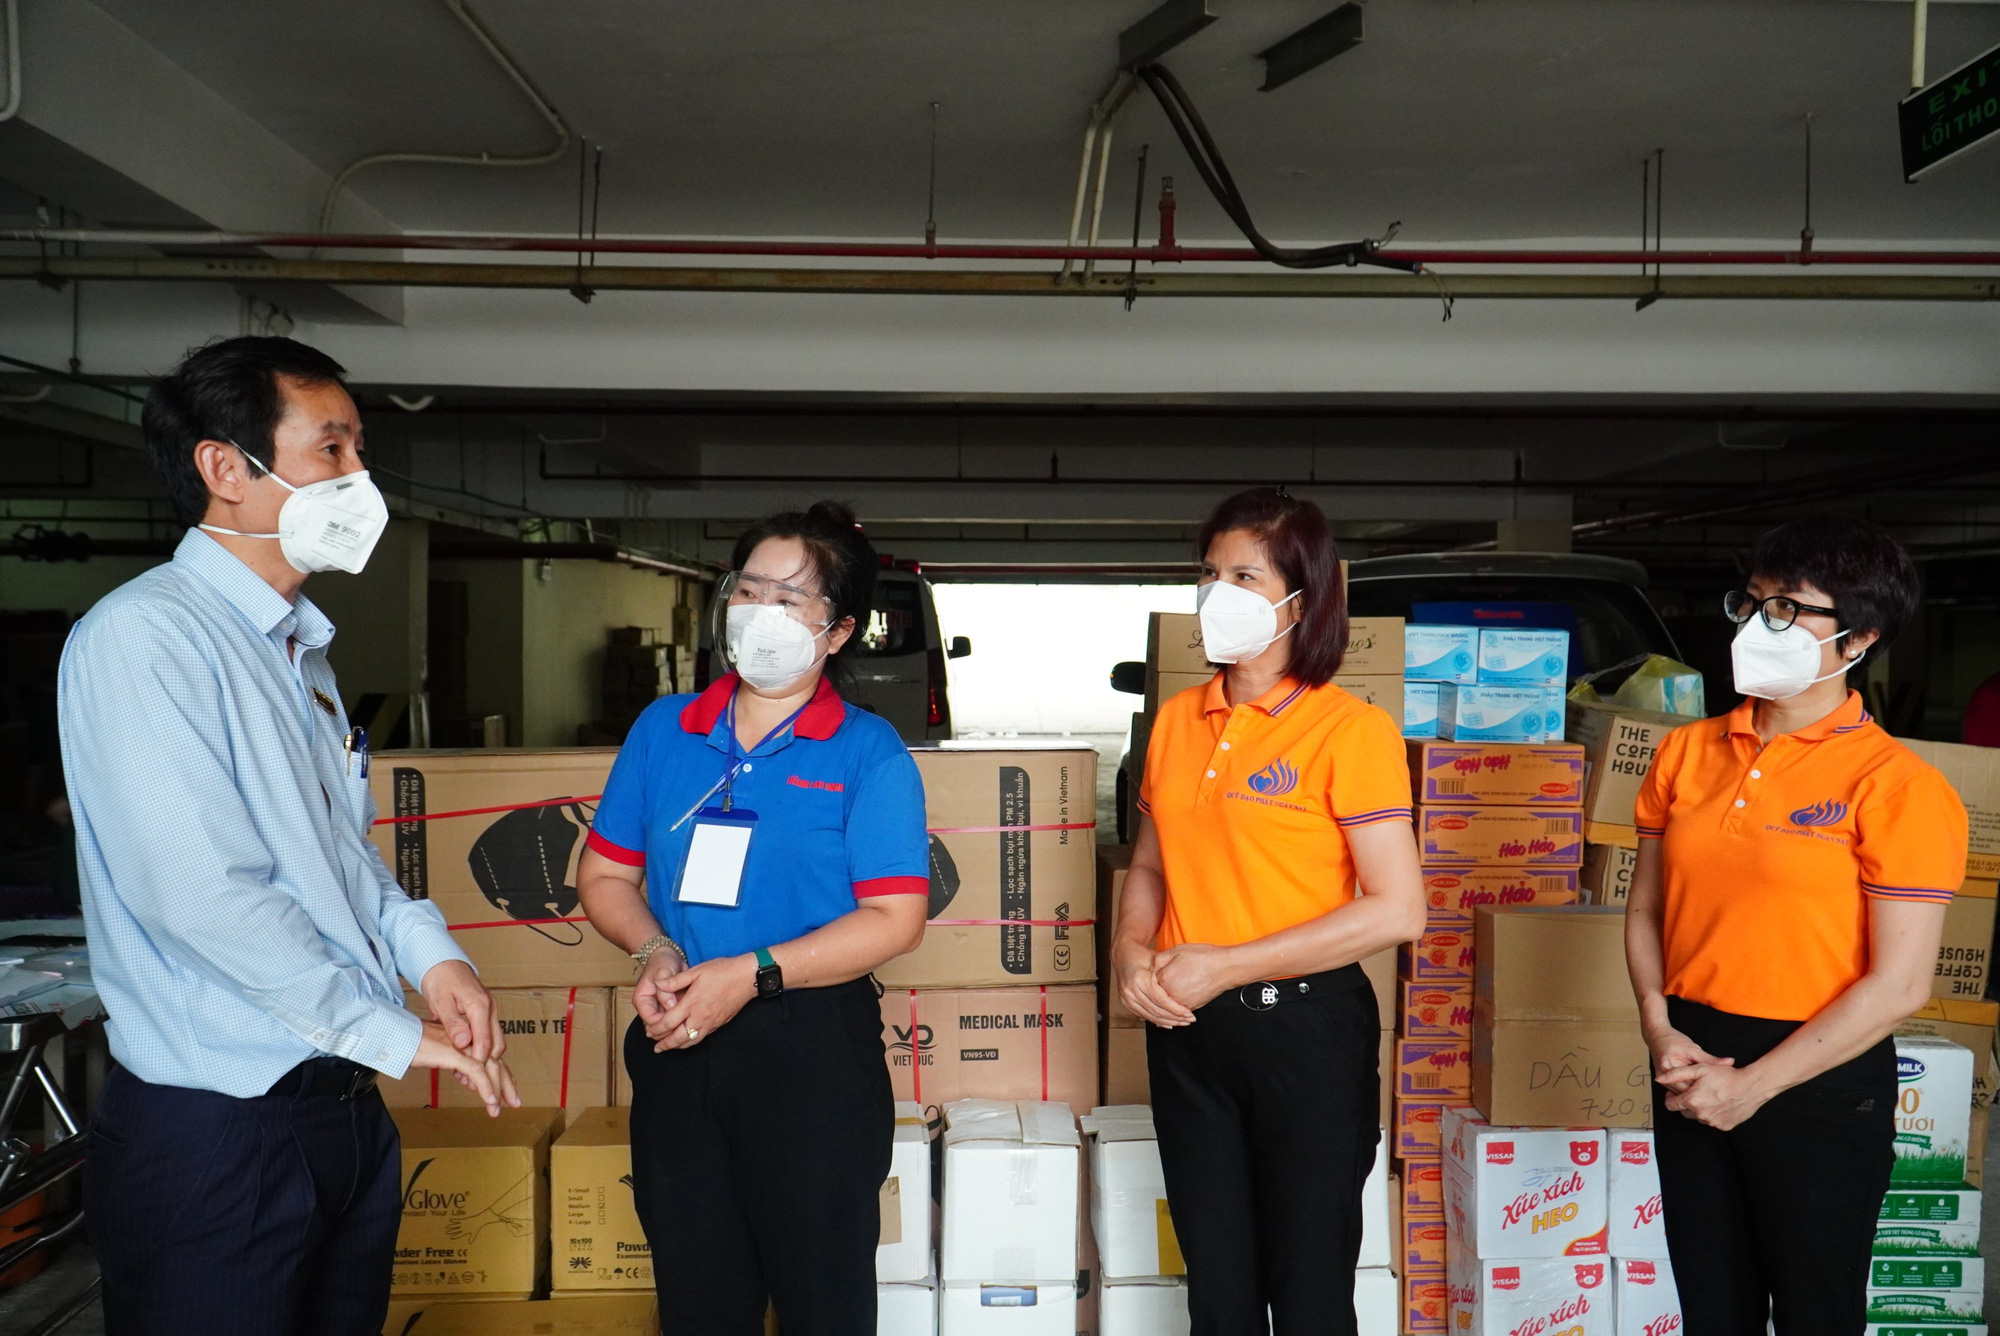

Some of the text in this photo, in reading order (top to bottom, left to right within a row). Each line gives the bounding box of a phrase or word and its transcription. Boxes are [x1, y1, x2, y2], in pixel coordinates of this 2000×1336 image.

[1953, 97, 1999, 133] THO
[1620, 725, 1651, 743] THE
[1616, 742, 1657, 761] COFF
[1611, 758, 1650, 777] HOU
[1006, 792, 1014, 806] 2.5
[1059, 766, 1068, 845] Mae in Vietnam
[1240, 794, 1254, 802] ĐẠO
[1006, 808, 1014, 820] PM
[1498, 836, 1556, 858] Hảo Hảo
[1006, 856, 1016, 876] sạch
[1006, 878, 1016, 894] Lọc
[1459, 880, 1536, 910] Hảo Hảo
[1016, 939, 1027, 962] Chống
[1938, 947, 1985, 962] HOUSE
[1934, 963, 1982, 979] COFFE
[1952, 981, 1980, 995] THE
[498, 1020, 536, 1034] RANG
[540, 1020, 548, 1034] Y
[959, 1014, 1020, 1030] MEDICAL
[892, 1054, 913, 1066] VIET
[1896, 1062, 1922, 1073] MILK
[1530, 1046, 1600, 1092] DẦU
[1620, 1152, 1650, 1160] VISSAN
[1532, 1202, 1579, 1235] HEO
[1634, 1194, 1663, 1230] Xú
[426, 1247, 454, 1257] Free
[616, 1242, 650, 1252] Powd
[1549, 1294, 1590, 1328] xích
